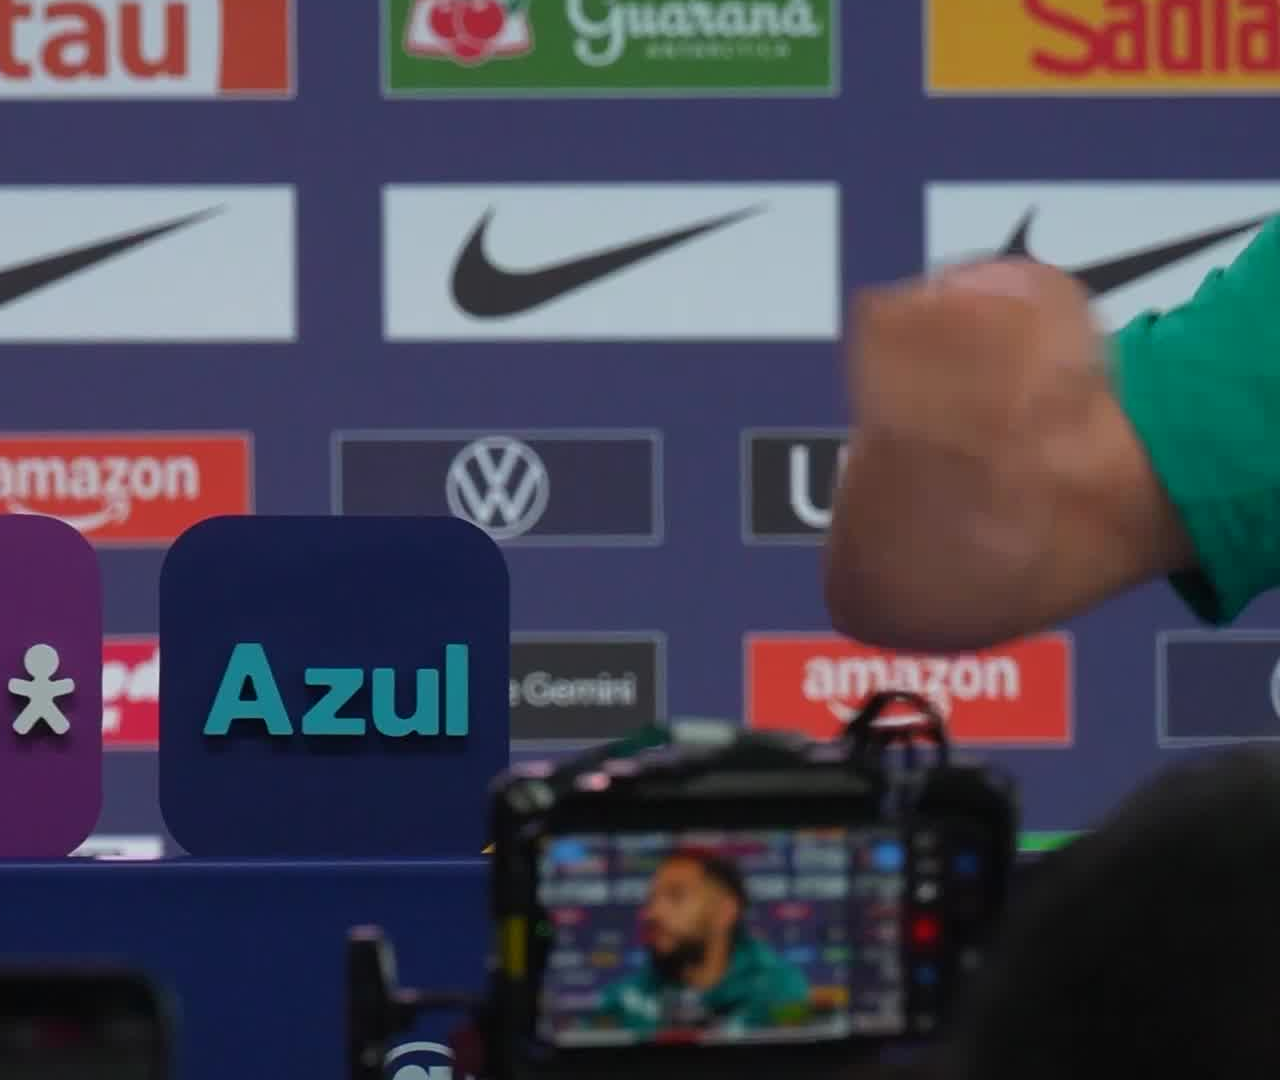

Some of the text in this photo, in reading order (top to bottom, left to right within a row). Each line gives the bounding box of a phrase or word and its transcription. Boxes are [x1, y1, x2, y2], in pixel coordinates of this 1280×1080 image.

[203, 643, 470, 737] Azul
[521, 673, 636, 707] Gemini
[802, 656, 1020, 700] amazon
